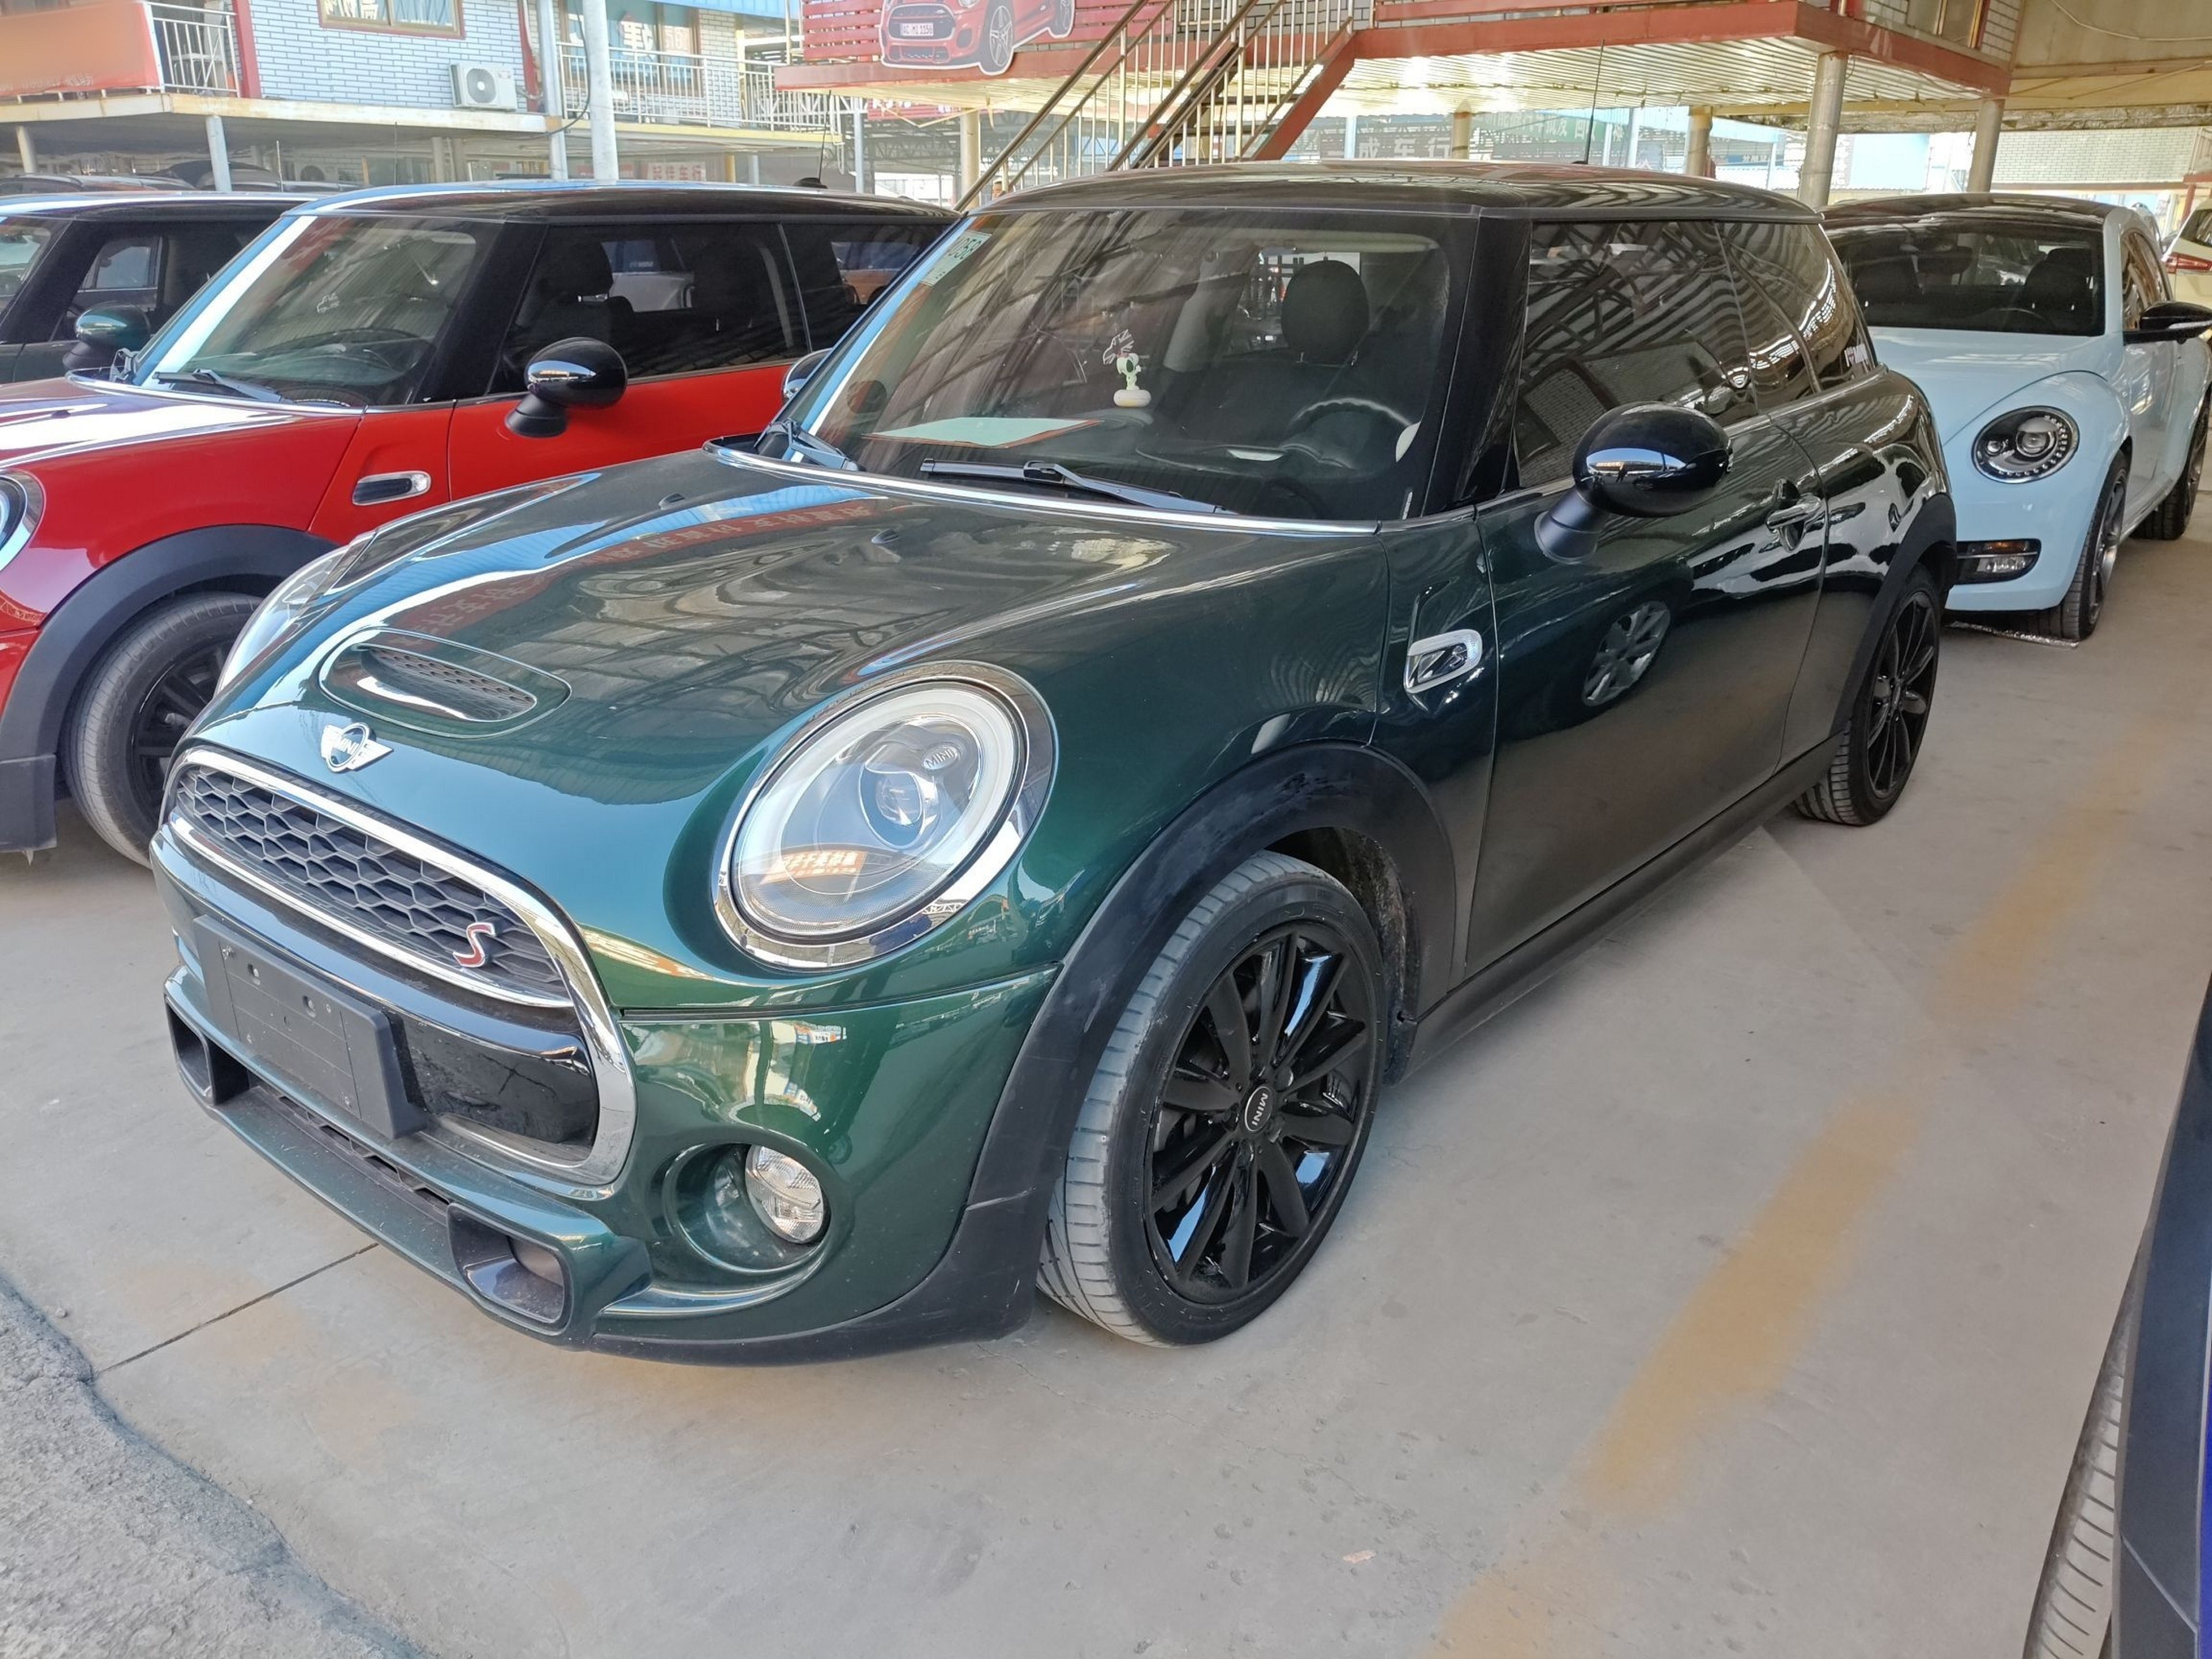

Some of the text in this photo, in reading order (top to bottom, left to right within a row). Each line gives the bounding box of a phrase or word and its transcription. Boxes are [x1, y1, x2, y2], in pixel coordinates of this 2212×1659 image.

[923, 748, 955, 768] MINI
[453, 922, 496, 968] S
[1251, 1093, 1268, 1126] MINI
